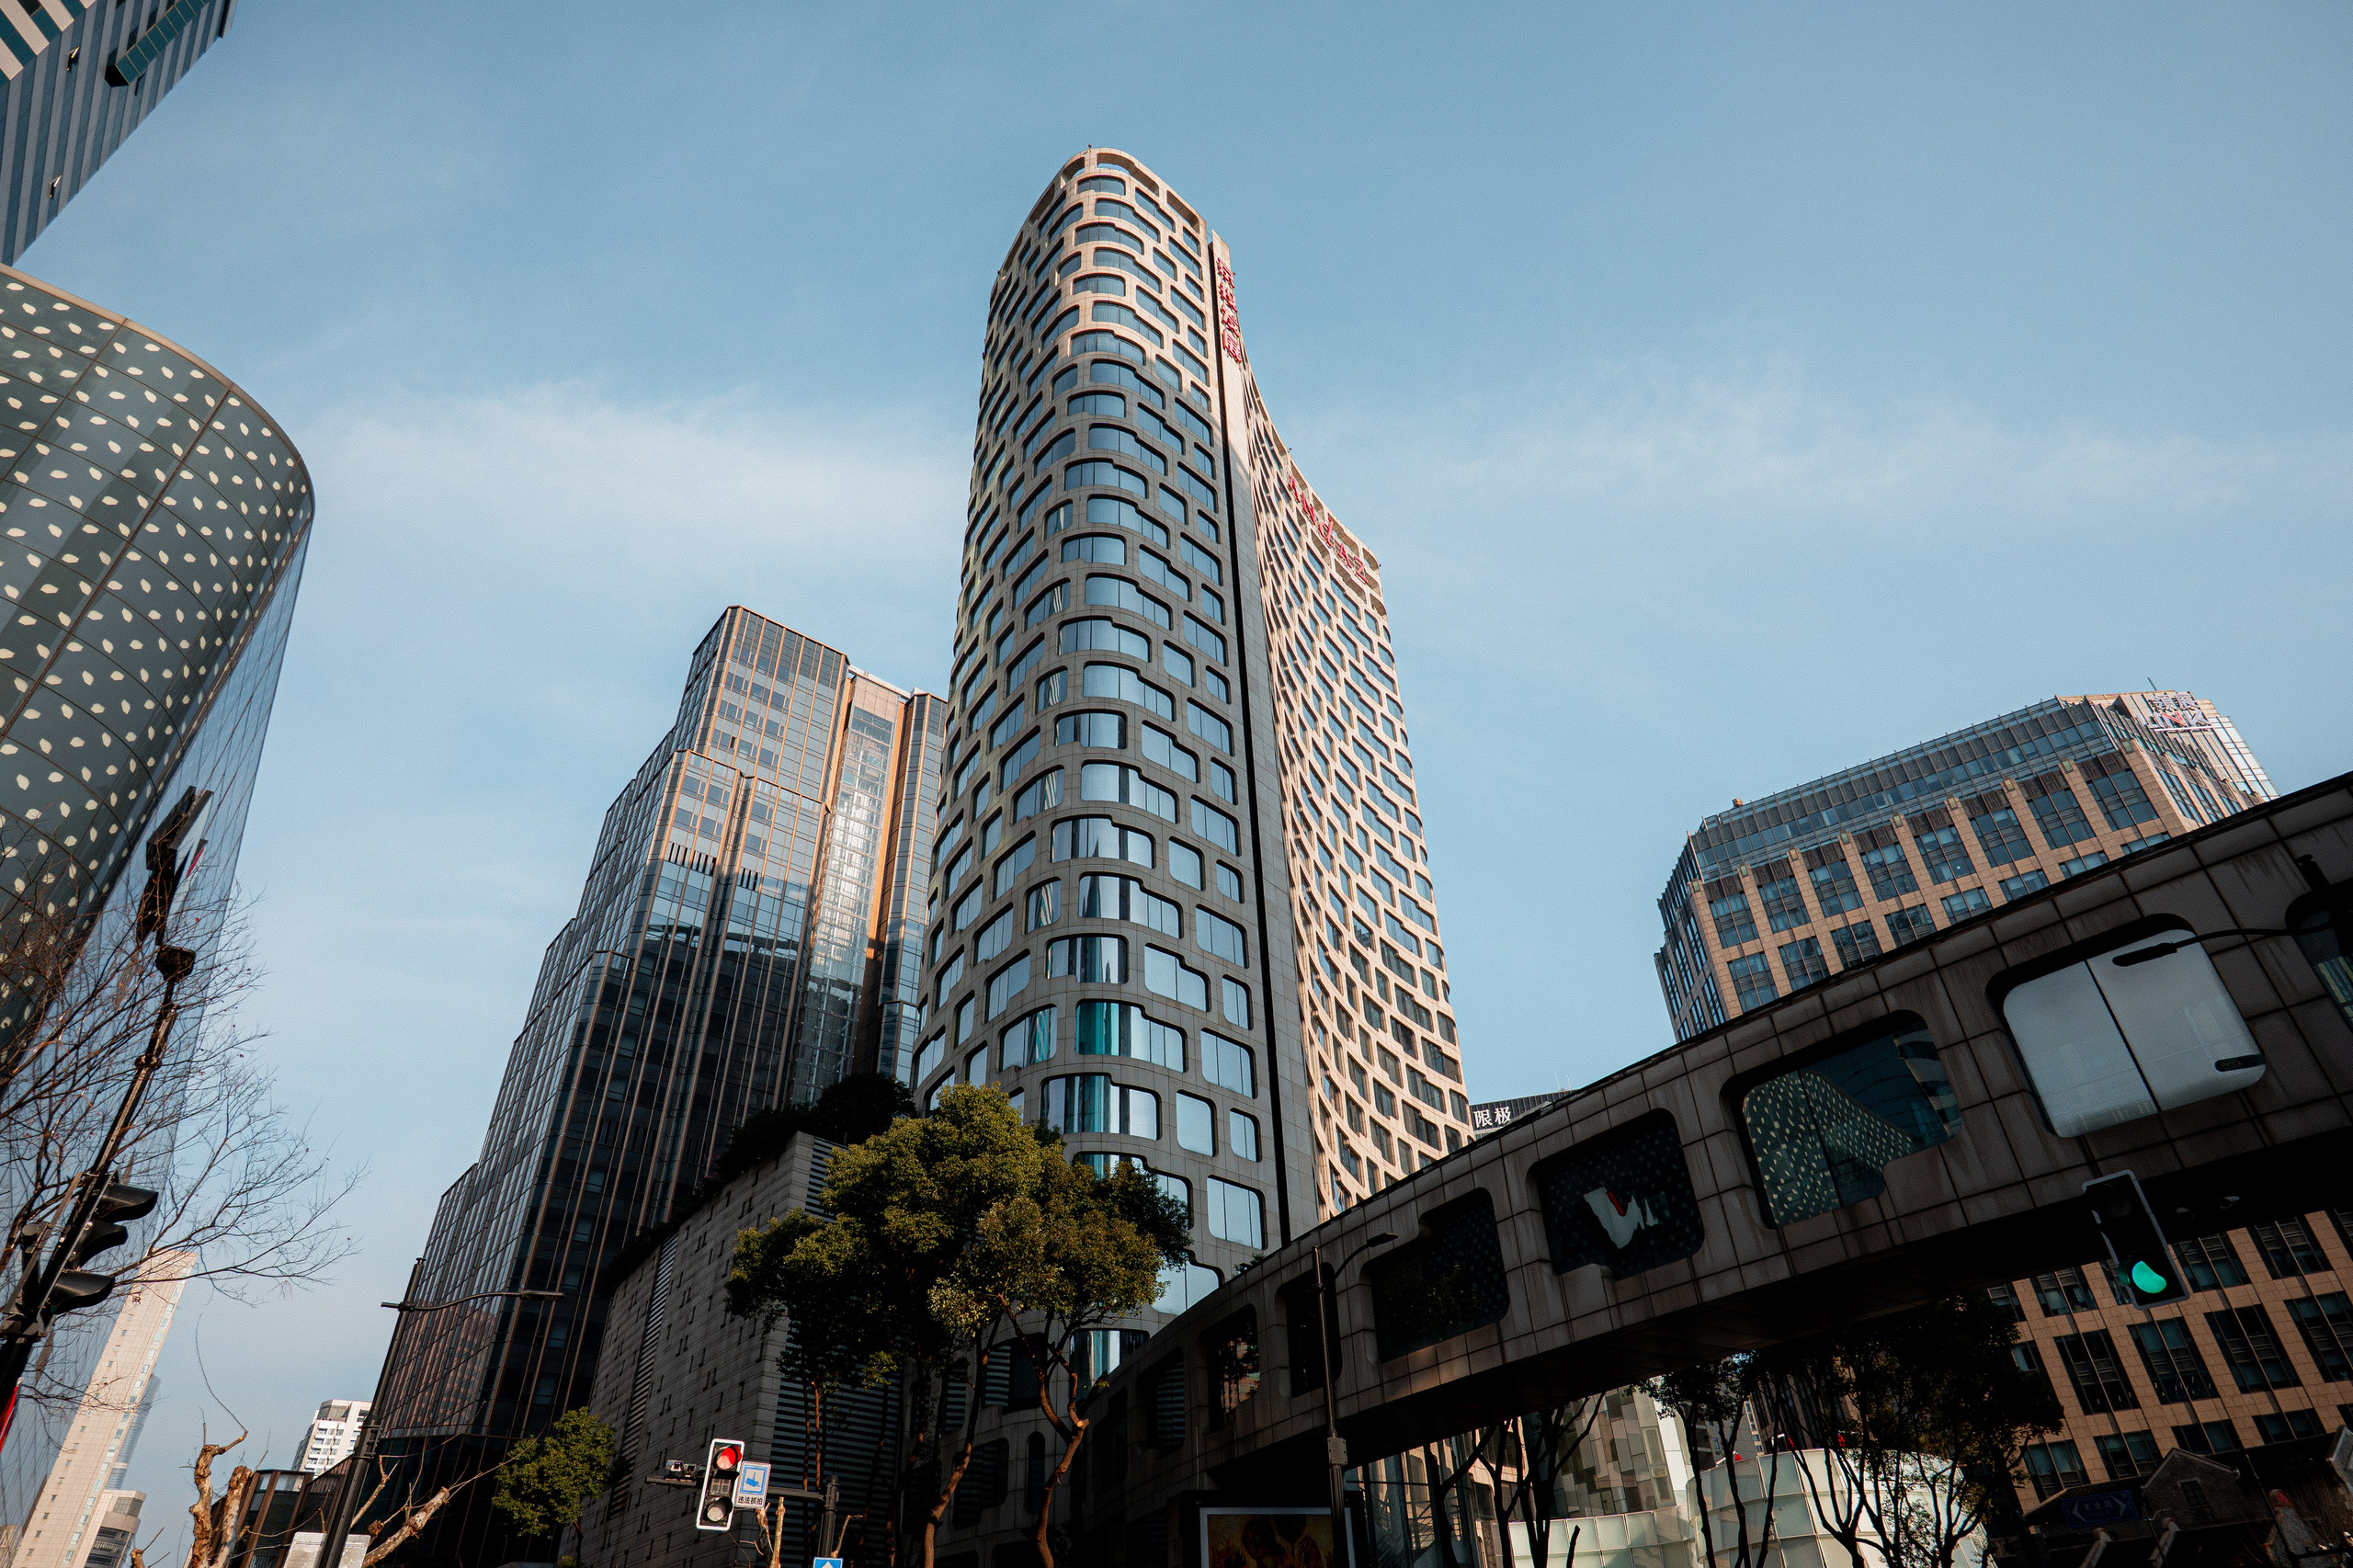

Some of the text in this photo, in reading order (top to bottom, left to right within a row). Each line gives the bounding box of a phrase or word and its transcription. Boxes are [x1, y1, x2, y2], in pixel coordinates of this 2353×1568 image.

[1473, 1107, 1511, 1129] 限极
[738, 1495, 764, 1506] 违法抓拍
